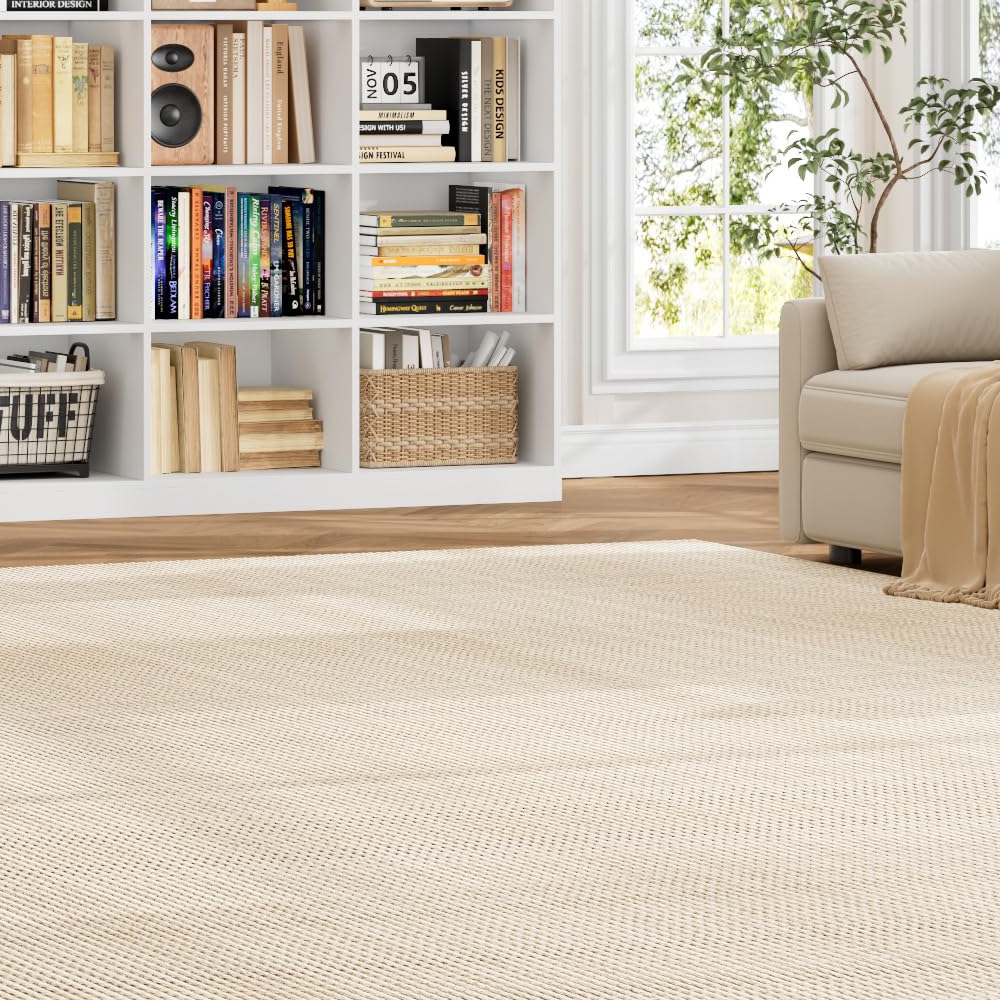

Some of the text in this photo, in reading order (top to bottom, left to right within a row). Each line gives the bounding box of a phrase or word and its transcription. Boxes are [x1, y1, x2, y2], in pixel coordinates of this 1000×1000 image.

[12, 0, 92, 8] INTERIOR DESIGN
[276, 41, 284, 74] England
[367, 68, 417, 98] NOV 05
[484, 79, 492, 156] THE NEXT DESIGN
[496, 69, 504, 139] KIDS DESIGN
